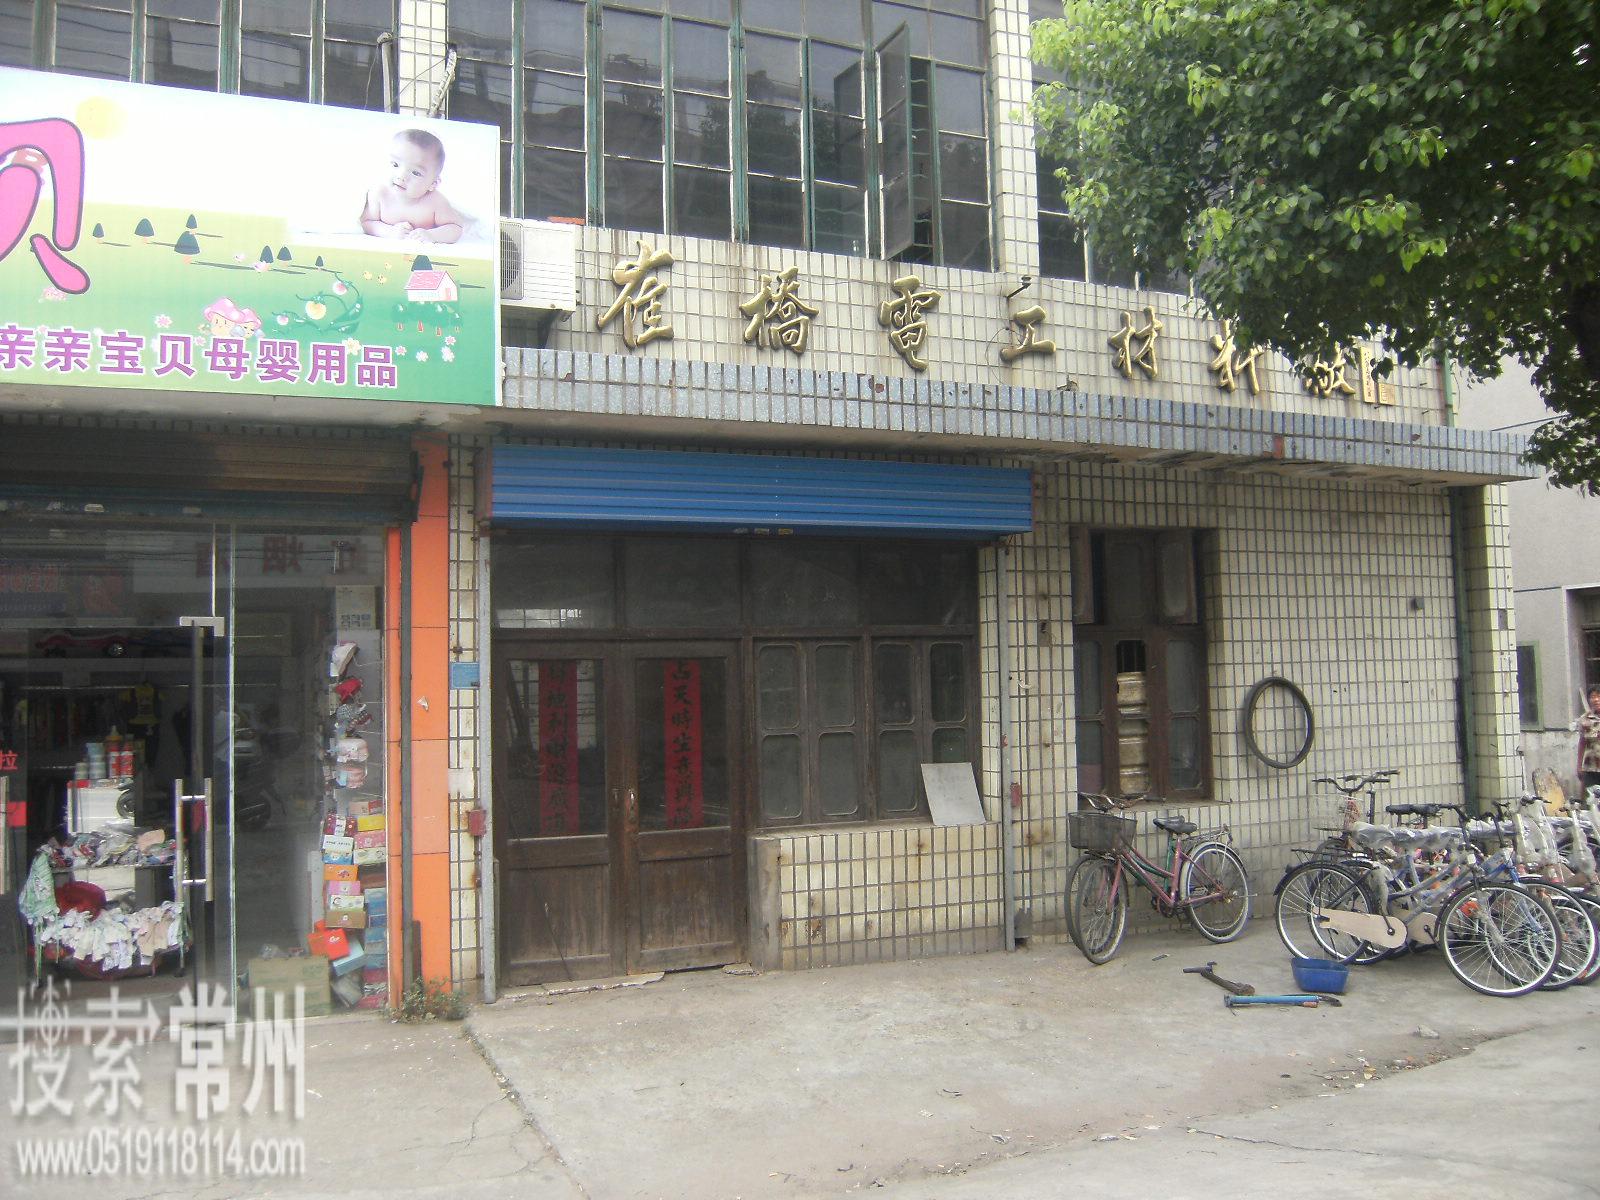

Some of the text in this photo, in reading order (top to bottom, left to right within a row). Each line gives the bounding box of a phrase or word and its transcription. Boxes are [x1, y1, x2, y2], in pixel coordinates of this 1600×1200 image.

[0, 325, 398, 389] 亲亲宝贝母婴用品
